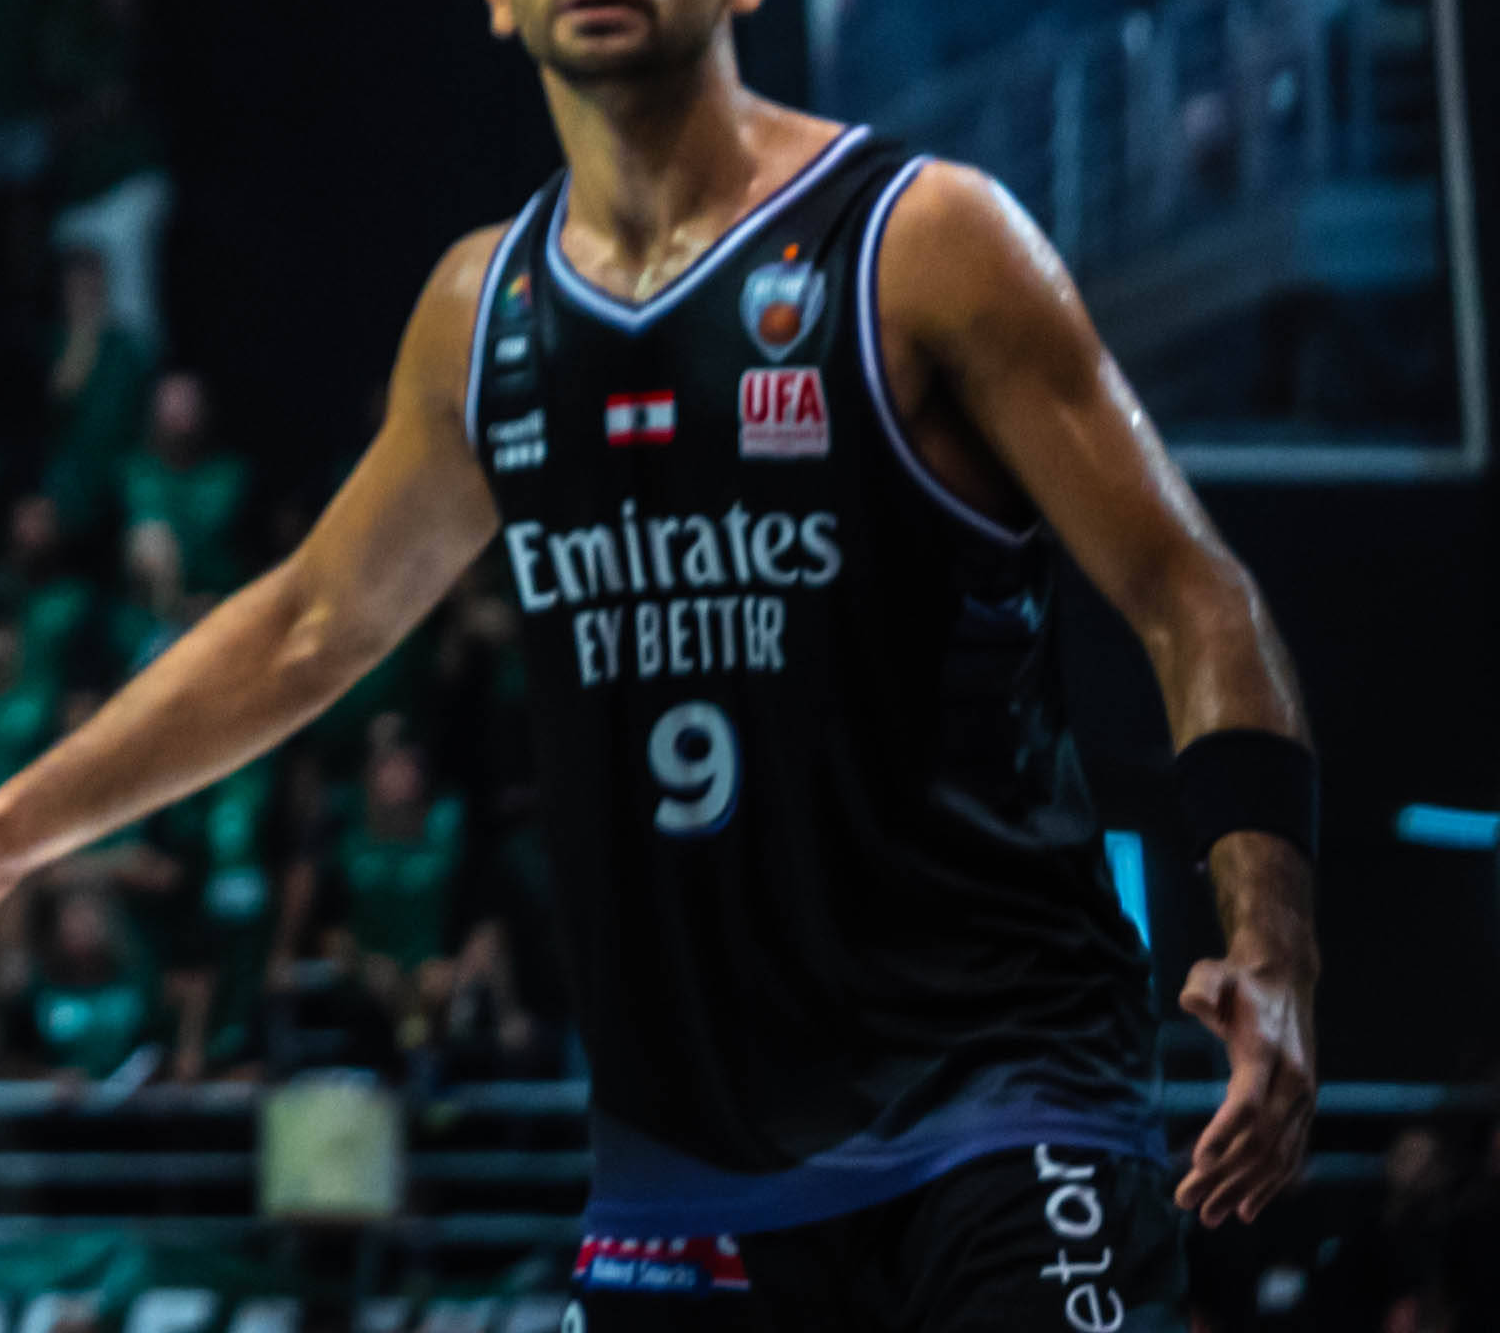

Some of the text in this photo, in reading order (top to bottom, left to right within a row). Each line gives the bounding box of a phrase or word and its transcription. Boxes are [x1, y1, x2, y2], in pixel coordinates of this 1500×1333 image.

[744, 372, 823, 424] UFA
[506, 498, 842, 614] Emirates
[647, 700, 742, 836] 9
